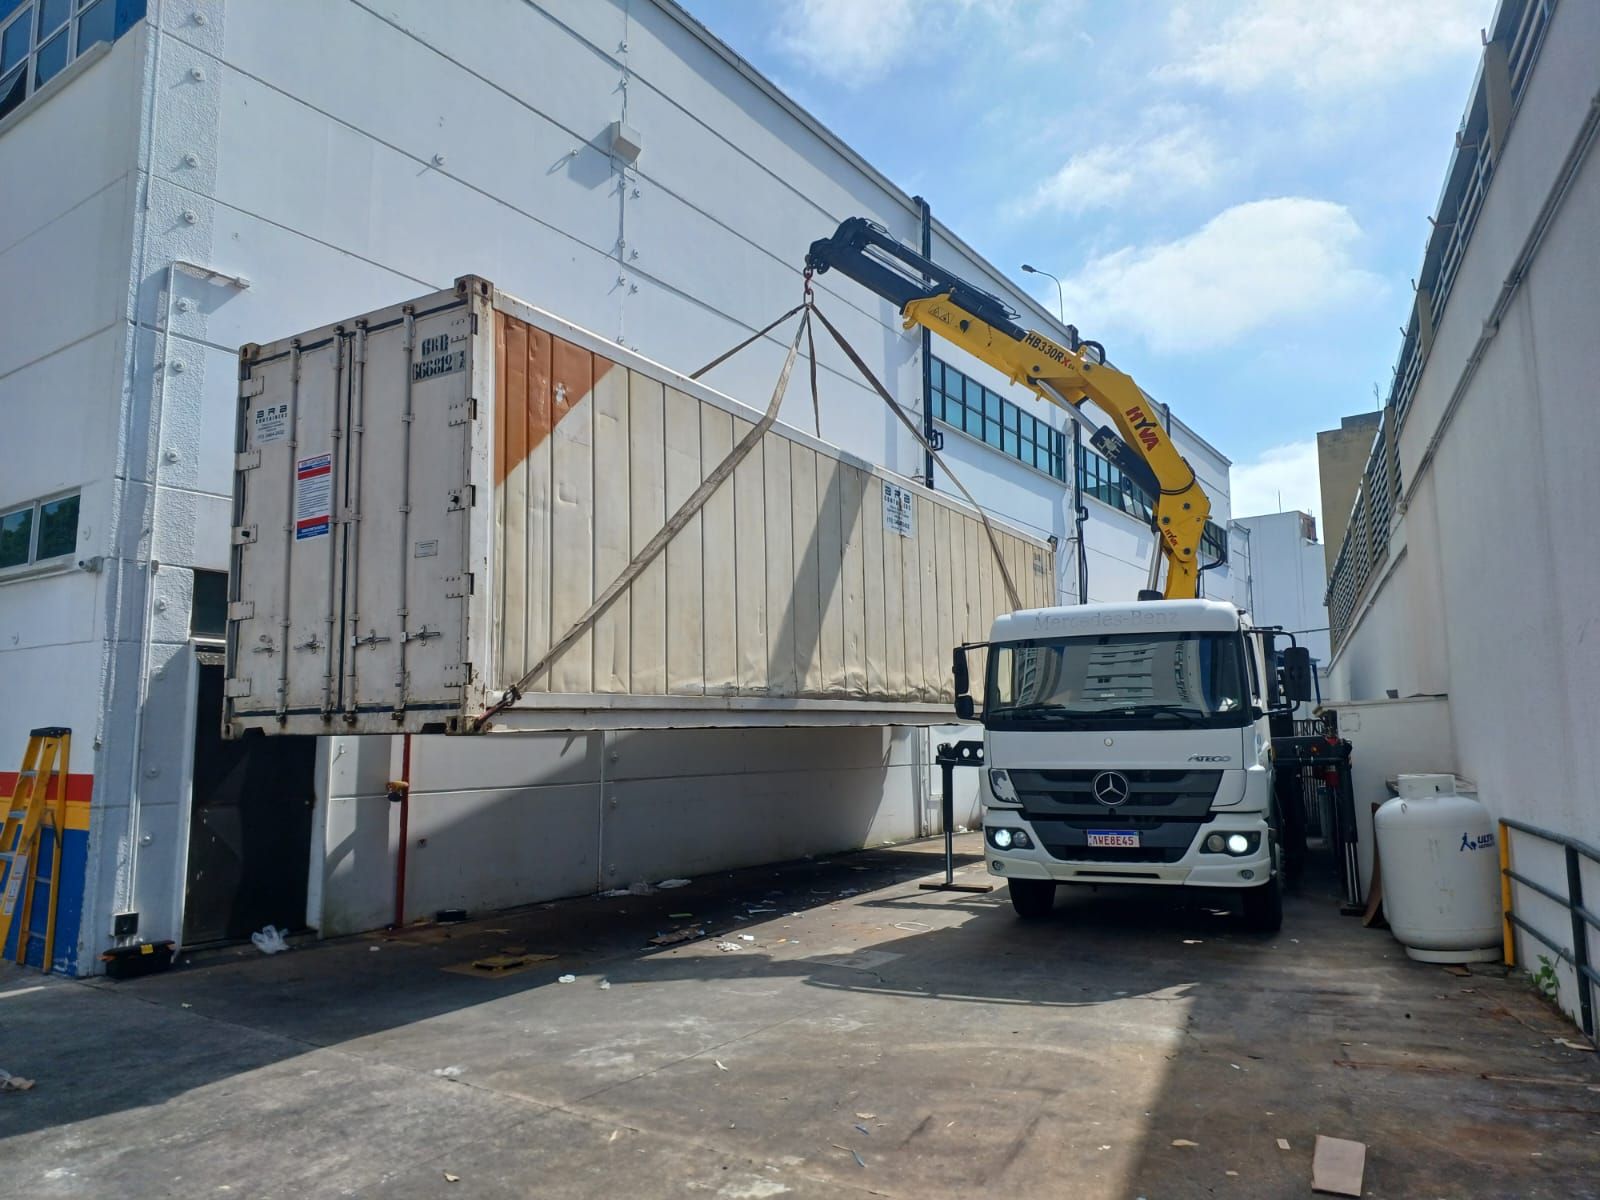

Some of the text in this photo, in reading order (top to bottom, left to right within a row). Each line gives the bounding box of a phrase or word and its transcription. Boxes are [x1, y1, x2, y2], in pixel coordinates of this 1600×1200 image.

[256, 404, 288, 419] BRB
[1125, 406, 1160, 452] HYVA
[1033, 610, 1179, 631] Mercedes-Benz
[1187, 754, 1232, 763] ATEGO
[1092, 835, 1135, 846] AWE8E45
